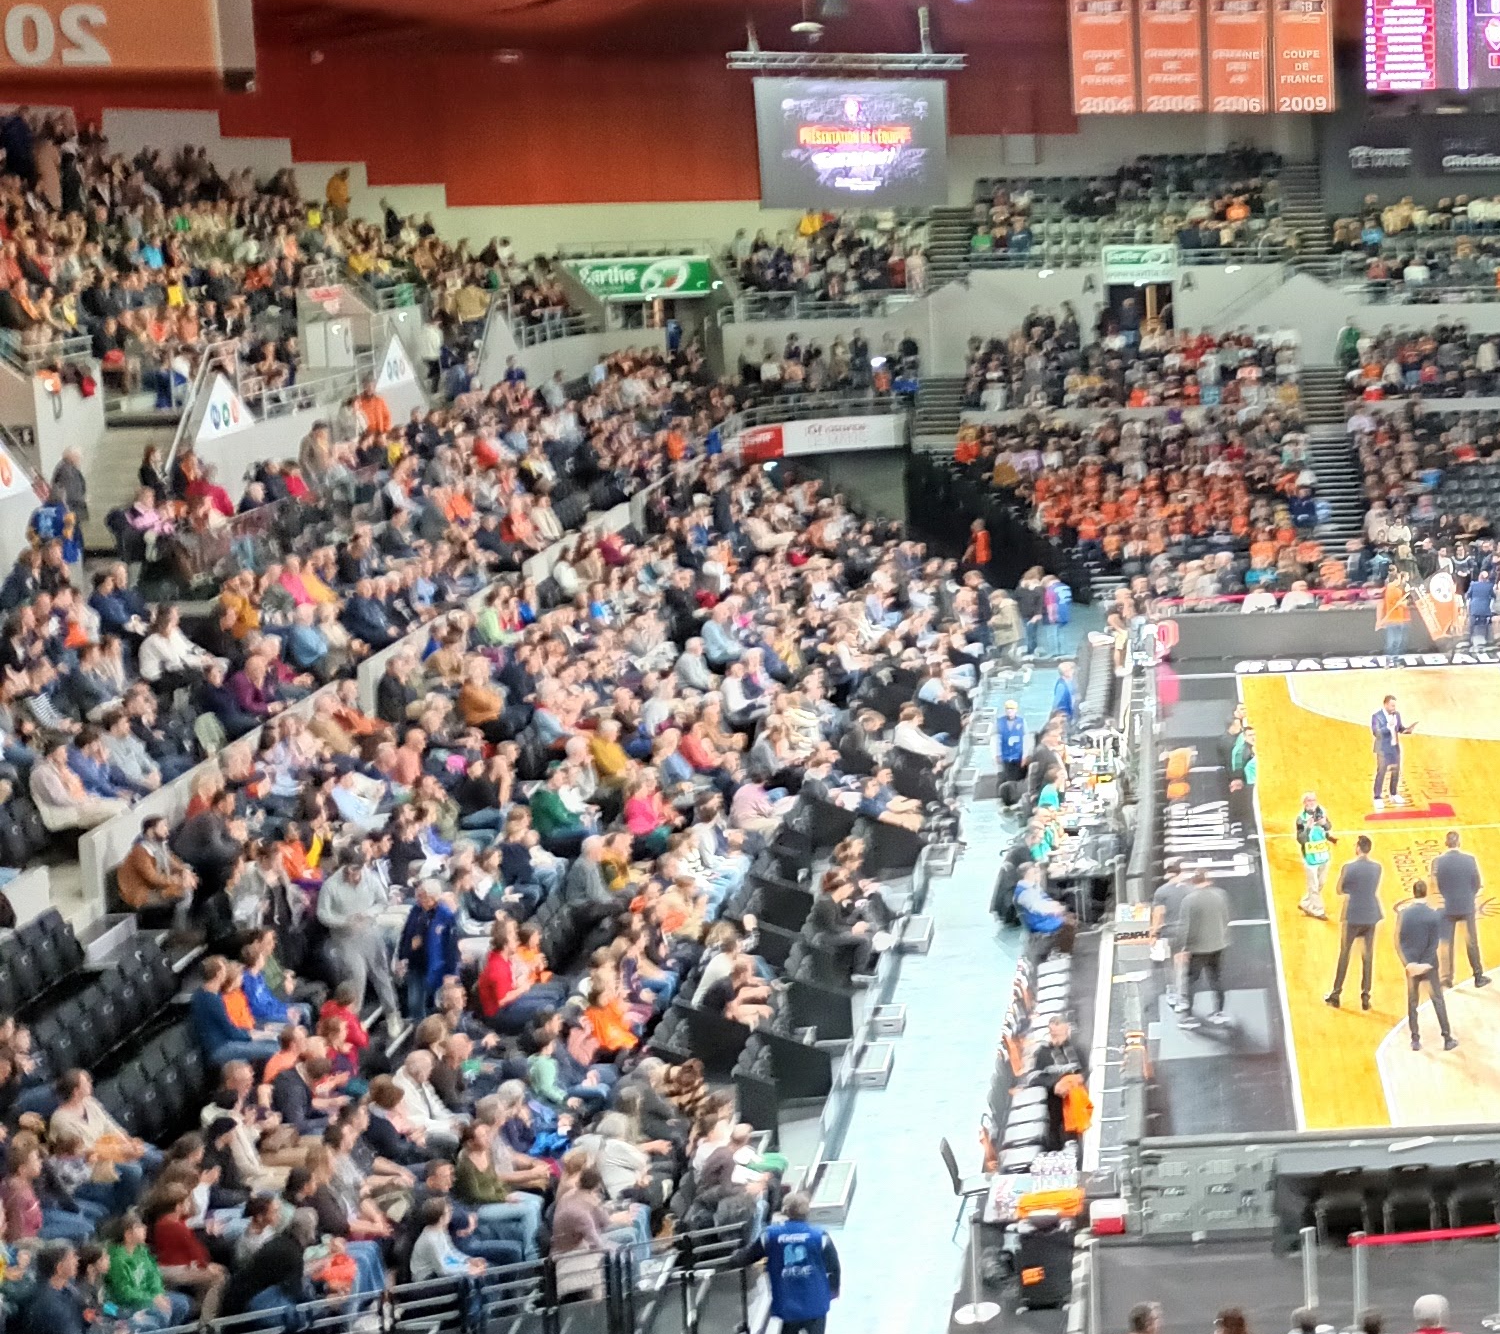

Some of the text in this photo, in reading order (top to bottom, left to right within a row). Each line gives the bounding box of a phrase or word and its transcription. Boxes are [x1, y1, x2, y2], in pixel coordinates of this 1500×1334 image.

[1282, 49, 1321, 59] COUPE
[1294, 62, 1310, 71] DE
[1280, 73, 1325, 84] FRANCE
[1279, 96, 1327, 112] 2009
